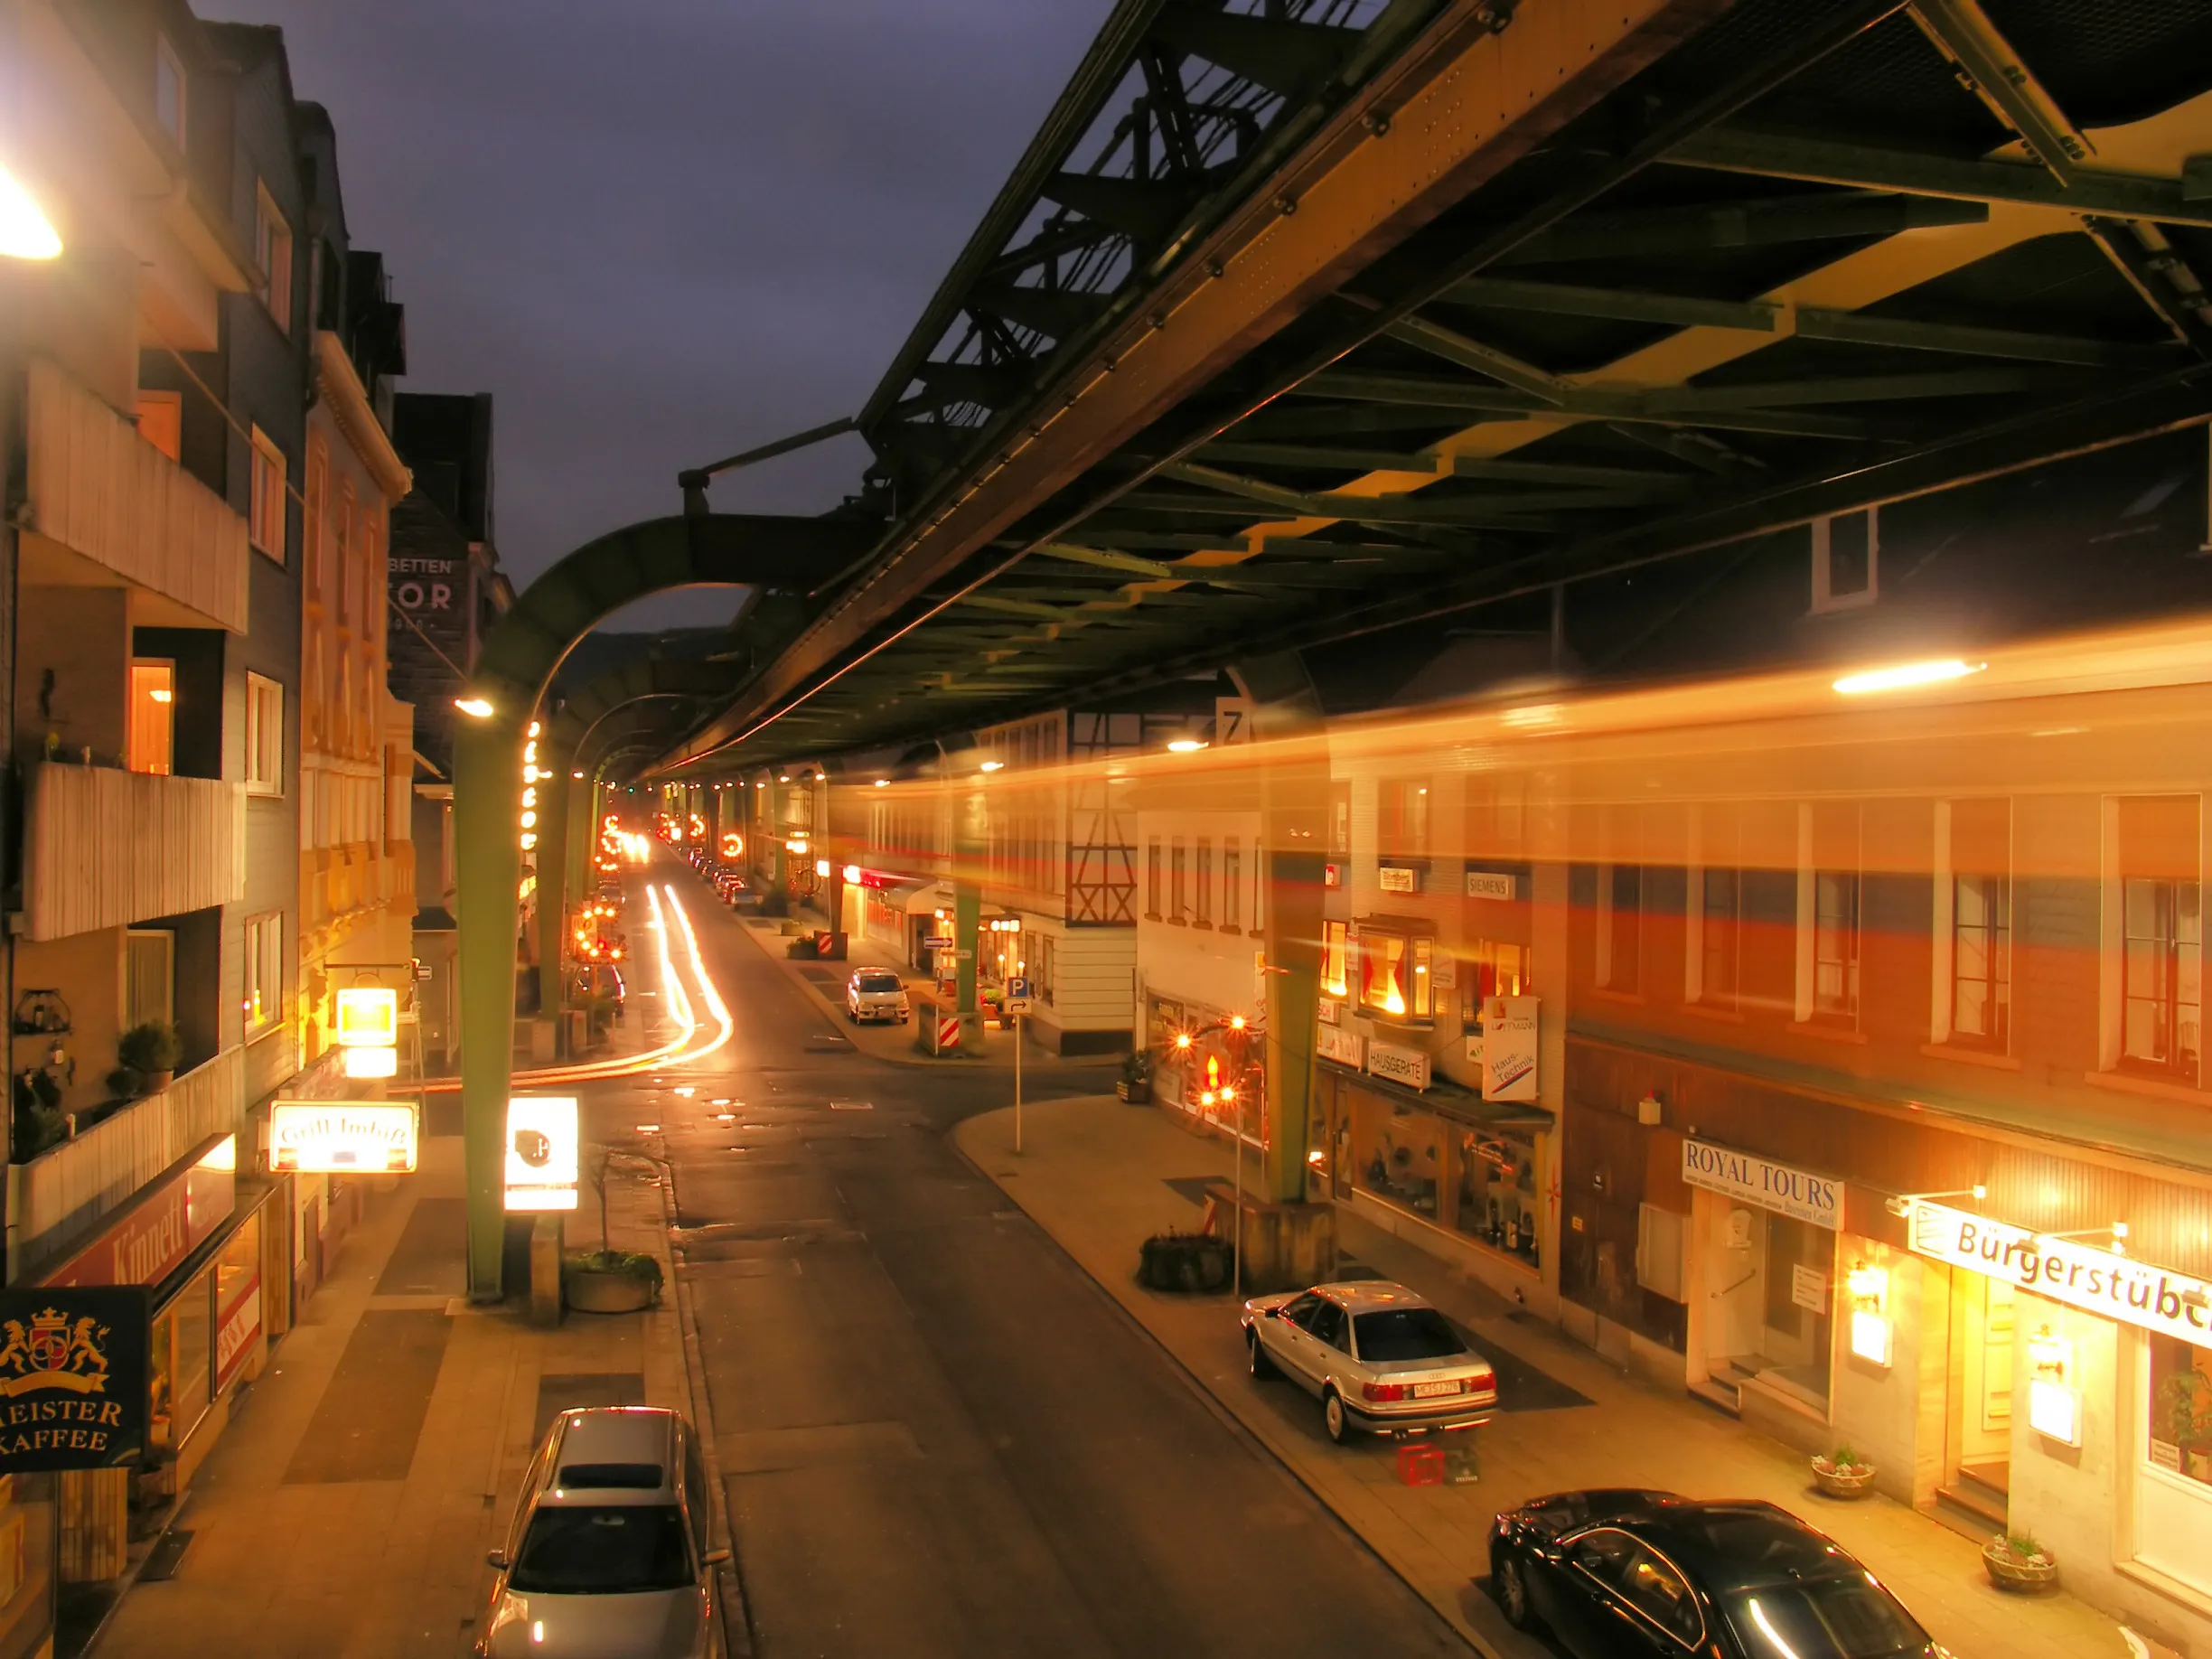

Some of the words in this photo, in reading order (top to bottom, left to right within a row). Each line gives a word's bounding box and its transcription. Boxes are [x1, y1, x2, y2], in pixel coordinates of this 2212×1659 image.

[389, 583, 451, 609] OR
[1469, 878, 1505, 895] SIEMENS
[1013, 979, 1024, 995] P
[1491, 1054, 1519, 1073] Haus-
[1497, 1055, 1535, 1083] Technik
[1686, 1143, 1754, 1186] ROYAL
[1760, 1165, 1835, 1211] TOURS
